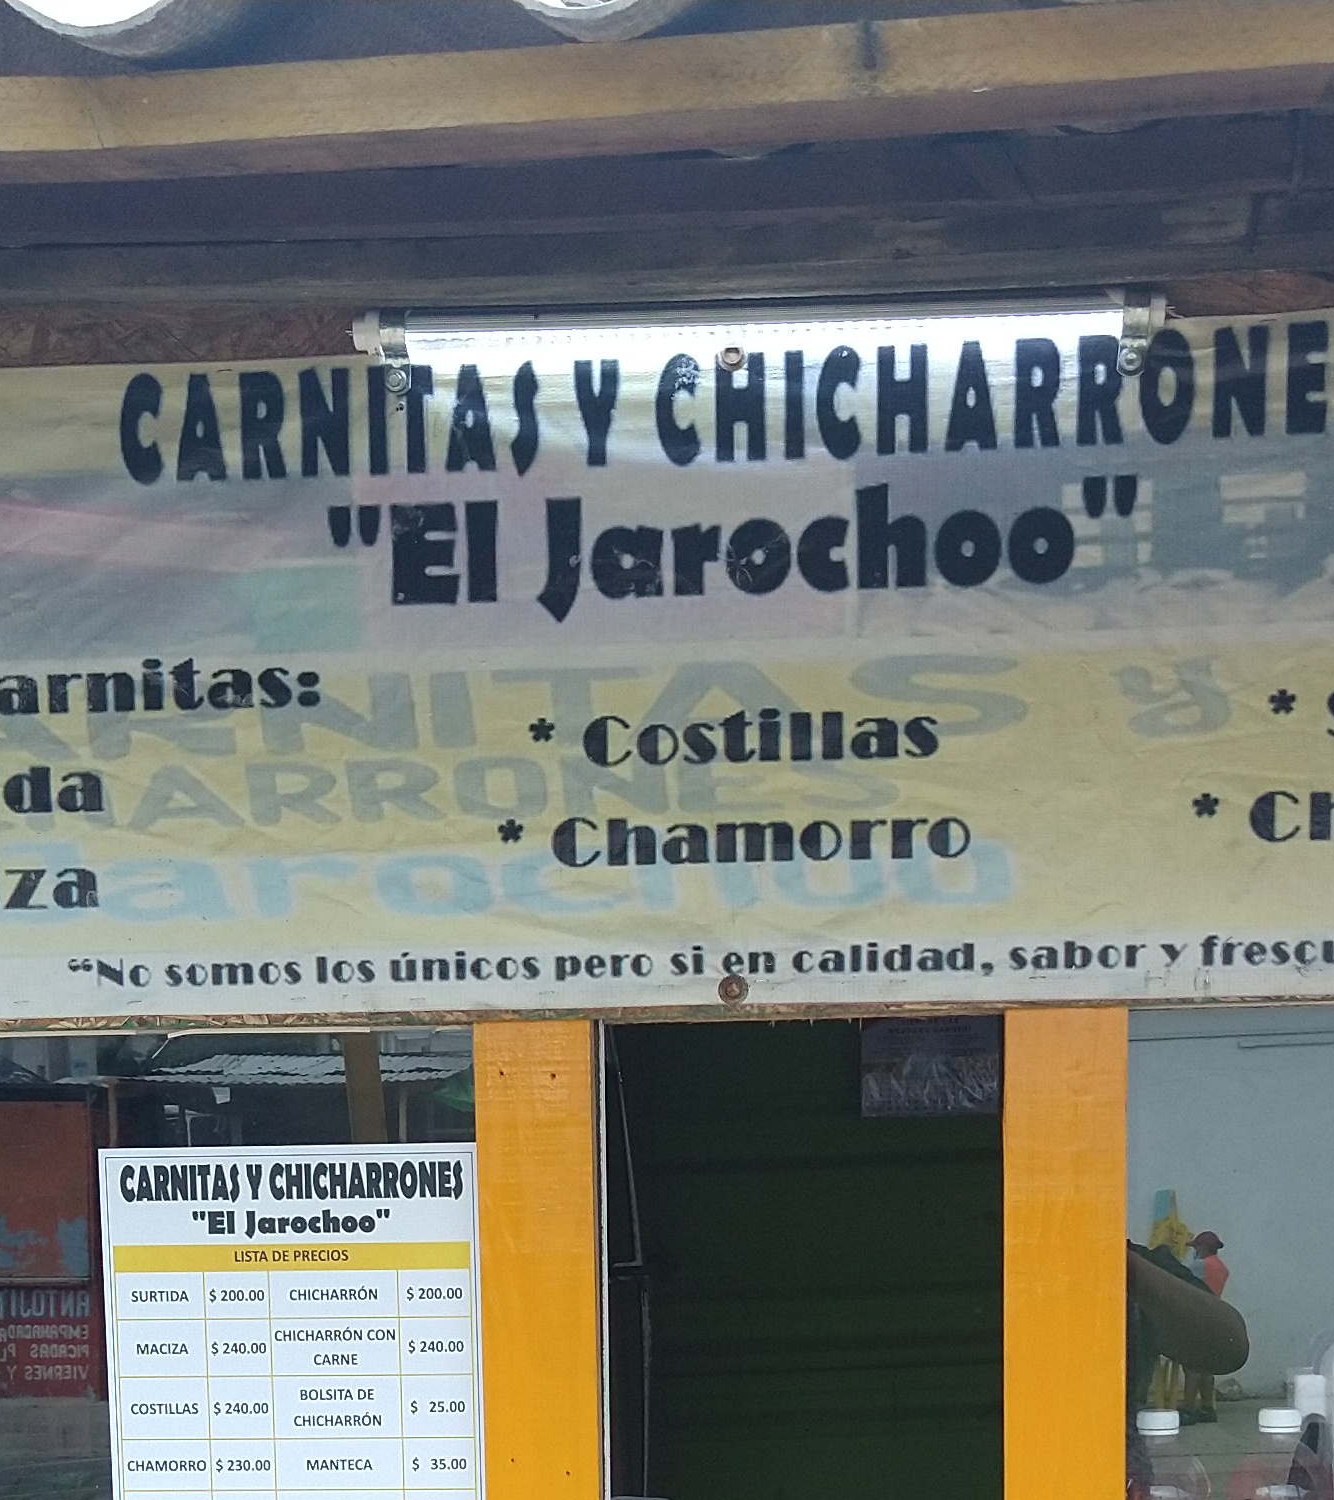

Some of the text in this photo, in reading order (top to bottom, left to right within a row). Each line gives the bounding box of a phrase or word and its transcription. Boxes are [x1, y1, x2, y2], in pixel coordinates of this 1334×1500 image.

[117, 363, 540, 486] CARNITAS
[572, 360, 618, 468] Y
[582, 712, 940, 770] Costillas
[552, 815, 971, 870] Chamorro
[164, 962, 302, 985] somos
[316, 956, 376, 982] los
[391, 952, 541, 983] únicos
[554, 952, 651, 983] pero
[664, 945, 705, 976] si
[720, 949, 776, 977] en
[790, 940, 993, 976] calidad,
[1008, 937, 1145, 970] sabor
[1159, 945, 1187, 973] y
[120, 1160, 464, 1203] CARNITAS Y CHICHARRONES
[234, 1250, 349, 1262] LISTA DE PRECIOS
[131, 1290, 189, 1303] SURTIDA
[289, 1286, 378, 1301] CHICHARRÓN
[274, 1327, 396, 1342] CHICHARRÓN CON
[136, 1343, 189, 1355] MACIZA
[314, 1354, 358, 1366] CARNE
[300, 1389, 374, 1402] BOLSITA DE
[131, 1403, 199, 1415] COSTILLAS
[430, 1402, 465, 1413] 25.00
[294, 1411, 382, 1427] CHICHARRÓN
[128, 1460, 207, 1472] CHAMORRO
[306, 1459, 373, 1471] MANTECA
[431, 1459, 467, 1471] 35.00
